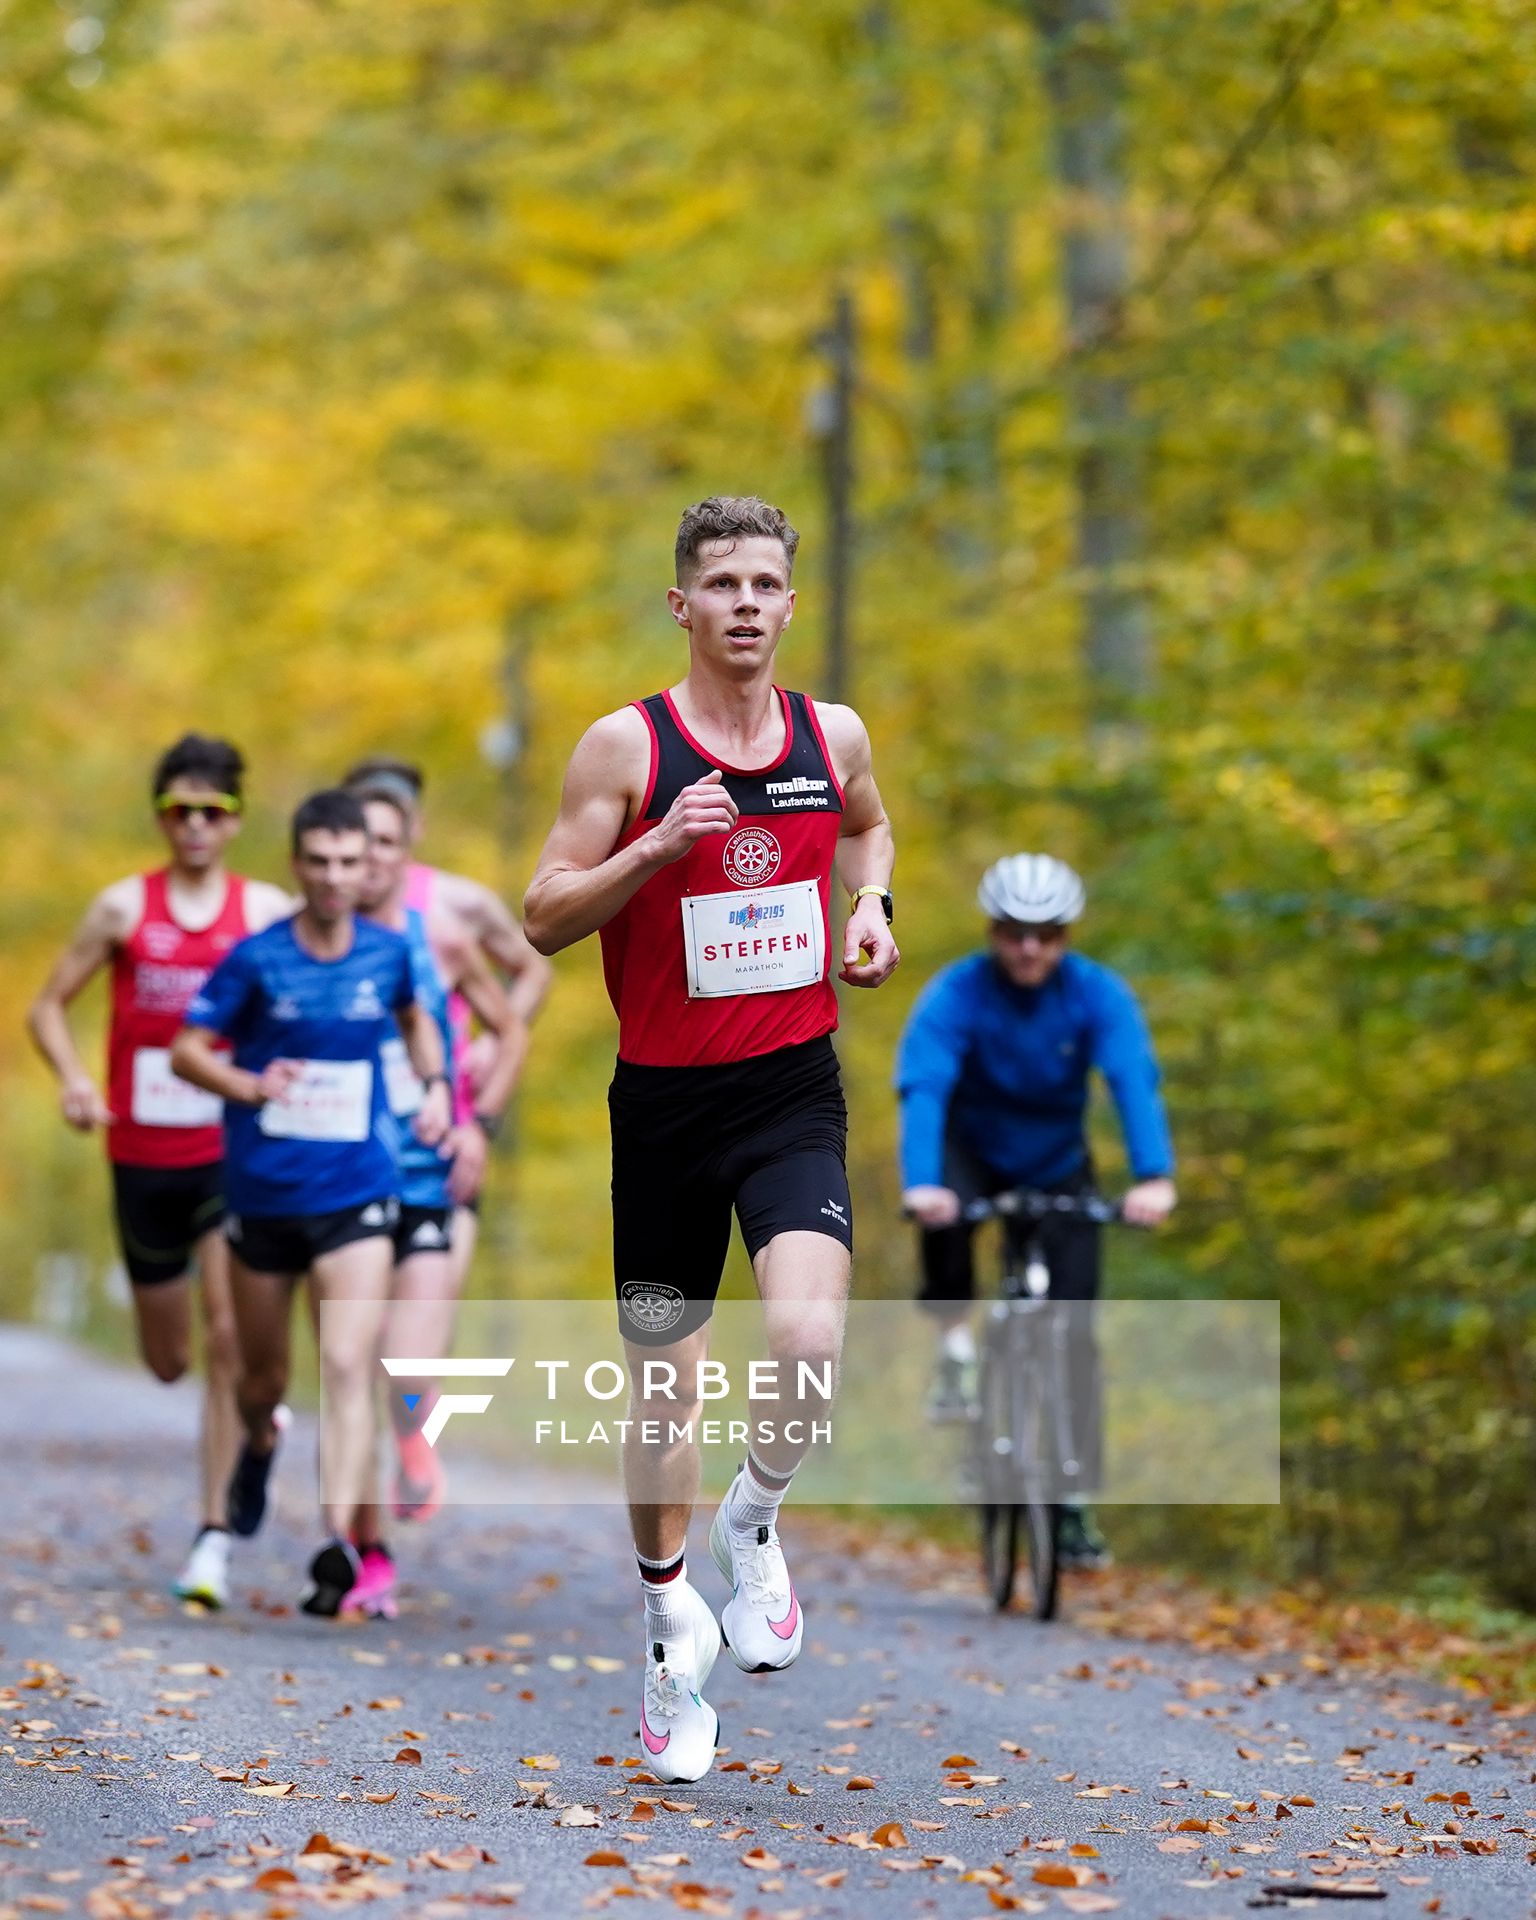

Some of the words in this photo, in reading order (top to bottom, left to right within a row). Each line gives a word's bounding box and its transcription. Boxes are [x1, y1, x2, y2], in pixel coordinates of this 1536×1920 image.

[766, 777, 828, 794] molitor
[772, 796, 828, 807] Laufanalyse
[703, 932, 808, 961] STEFFEN
[735, 962, 784, 974] MARATHON
